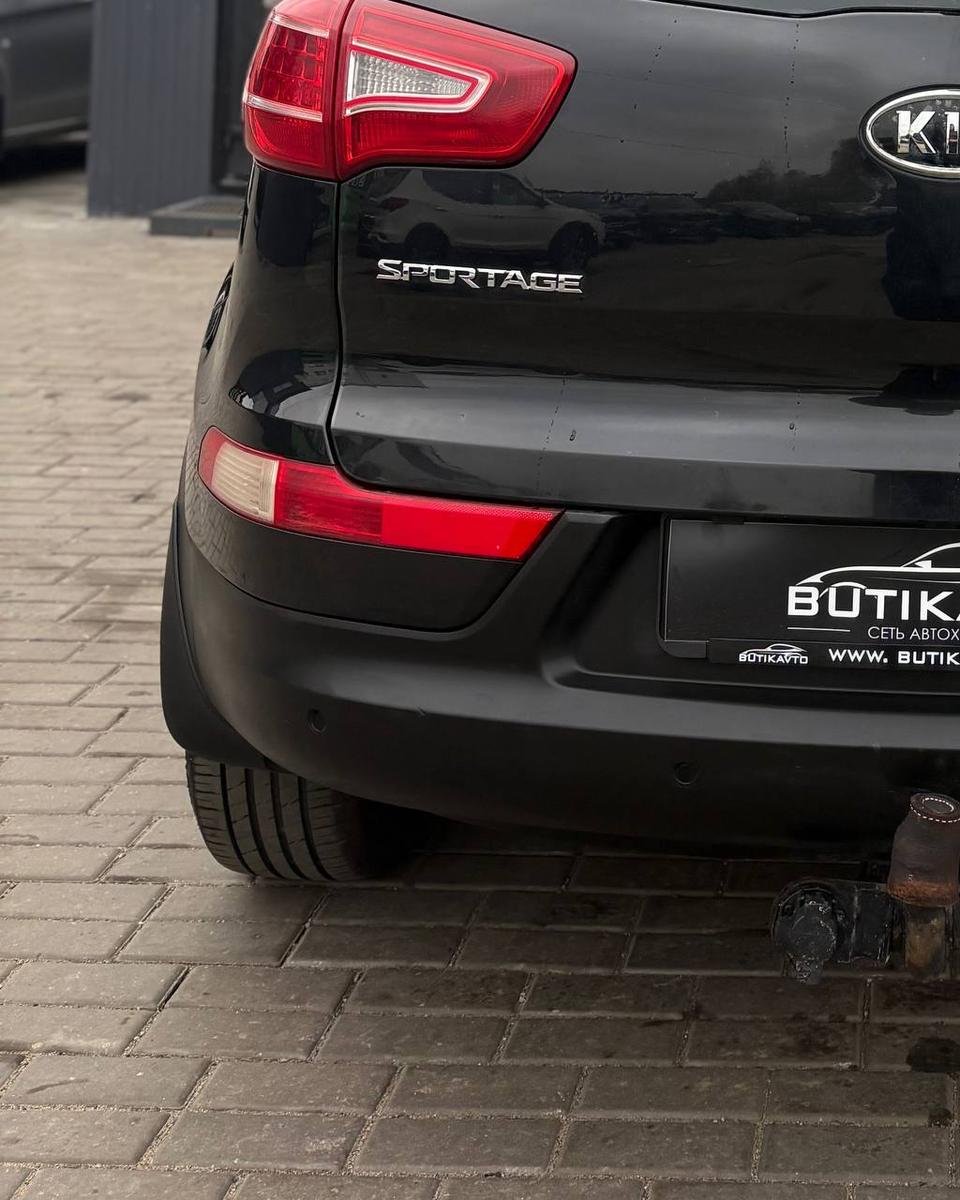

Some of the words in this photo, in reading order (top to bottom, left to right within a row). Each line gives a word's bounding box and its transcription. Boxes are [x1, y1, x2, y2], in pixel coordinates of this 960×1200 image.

[376, 258, 583, 294] SPORTAGE
[867, 626, 905, 641] СЕТЬ
[738, 653, 809, 665] BUTIKAVTO
